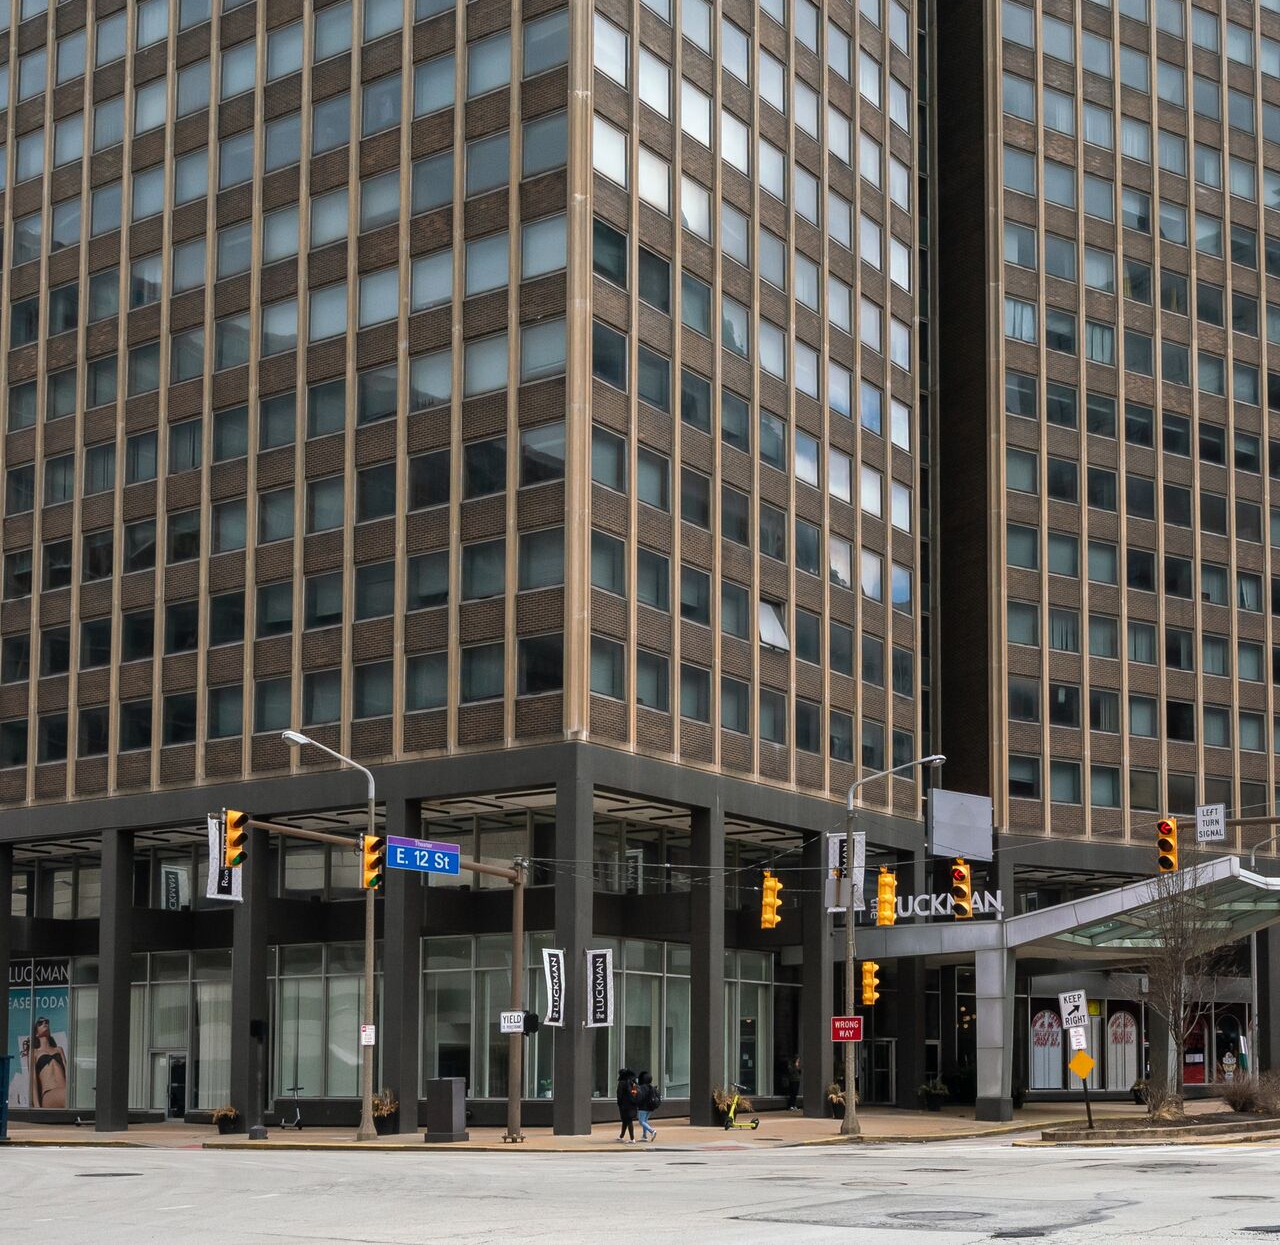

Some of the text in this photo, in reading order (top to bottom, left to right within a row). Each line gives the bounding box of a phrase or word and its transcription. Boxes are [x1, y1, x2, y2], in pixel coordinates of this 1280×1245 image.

[1202, 808, 1218, 817] LEFT
[1202, 819, 1220, 827] TURN
[1199, 829, 1223, 838] SIGNAL
[414, 840, 433, 849] Theater
[396, 848, 450, 870] E. 12 St
[897, 889, 1003, 918] UCKAN
[550, 957, 560, 1011] LUCKMAN
[596, 958, 605, 1011] LUCKMAN
[1064, 994, 1082, 1004] KEEP
[503, 1014, 522, 1024] YIELD
[835, 1020, 859, 1028] WRONG
[1065, 1015, 1087, 1026] RIGHT
